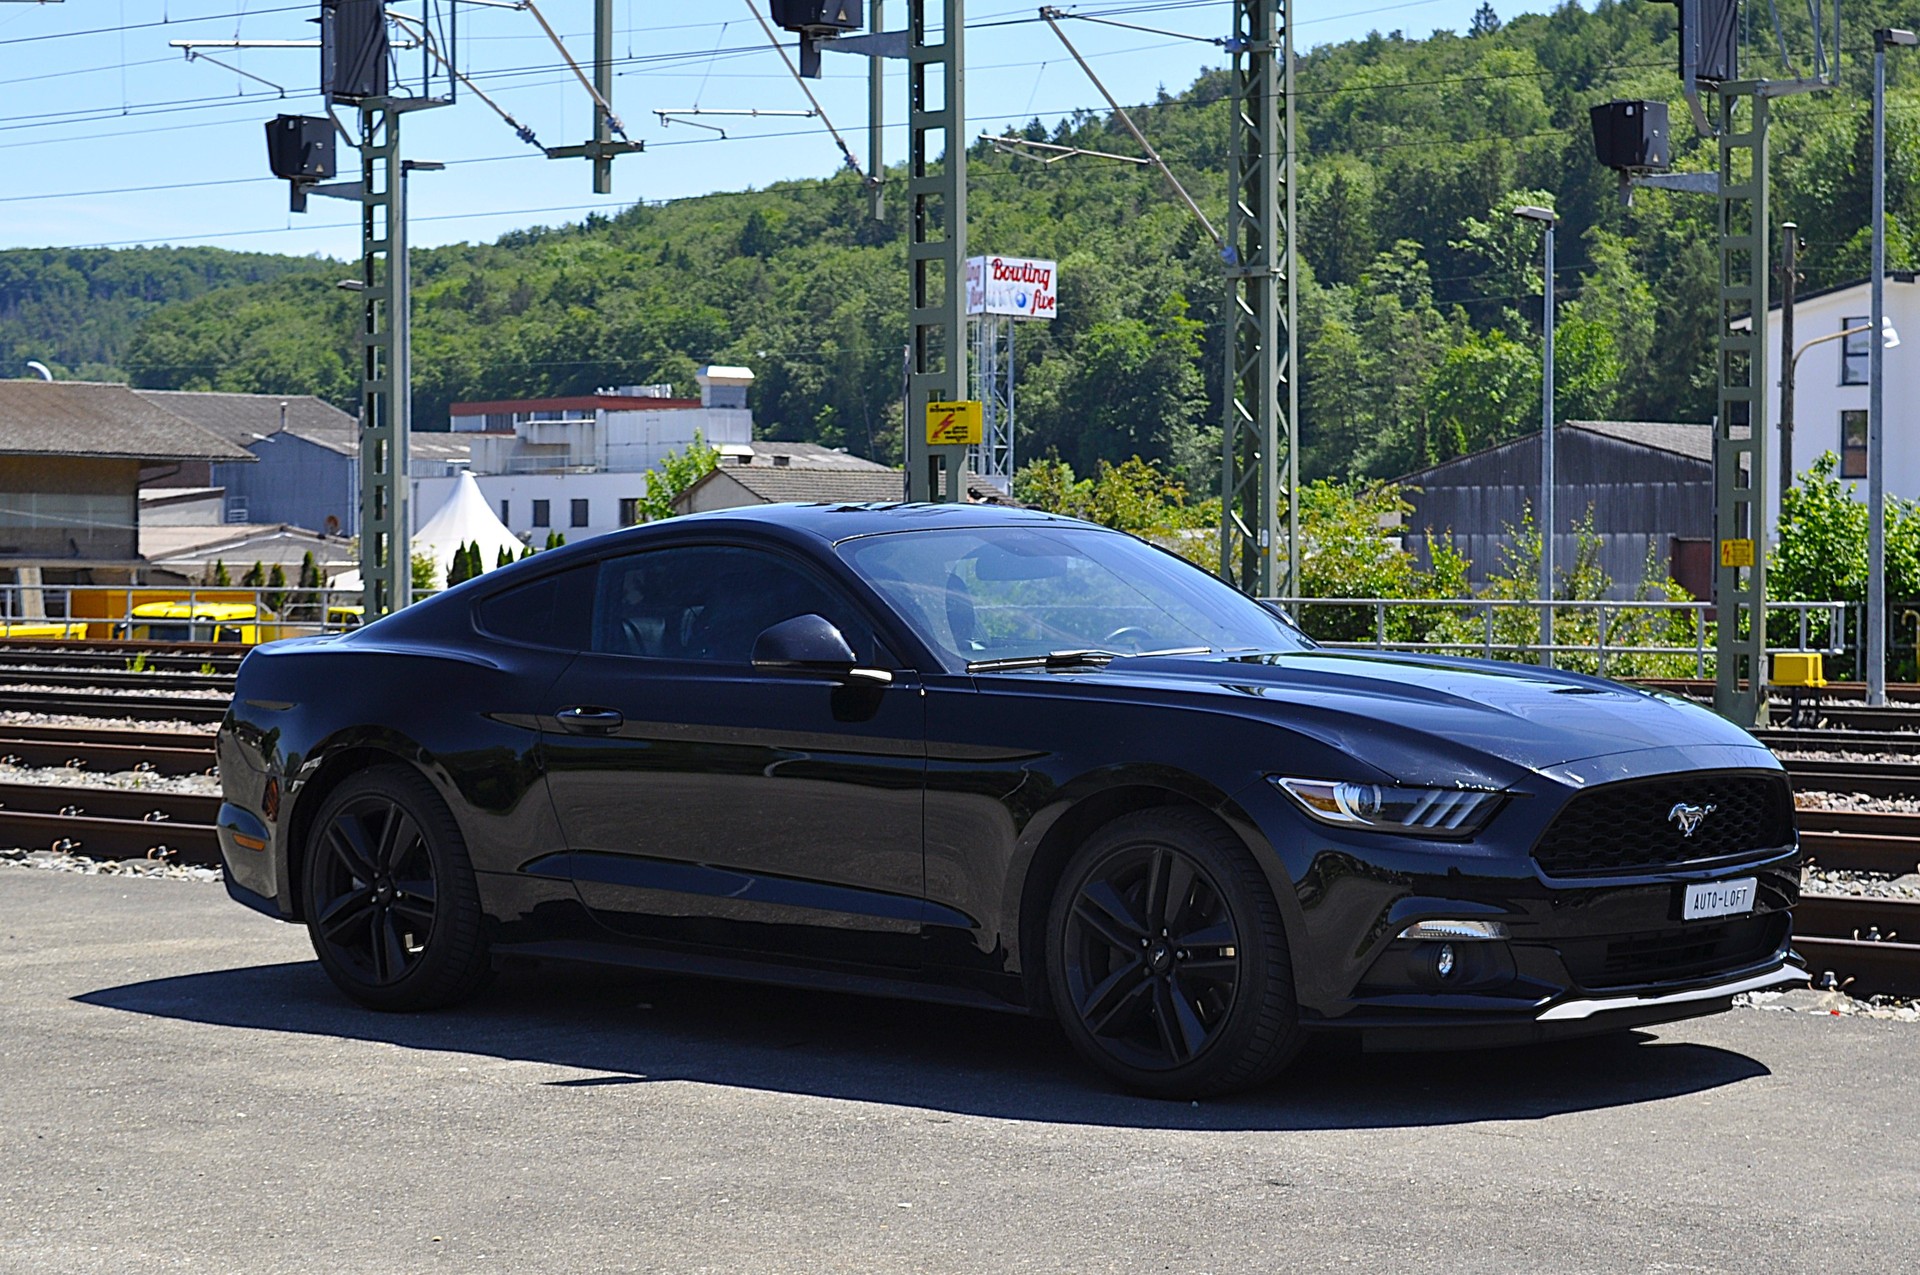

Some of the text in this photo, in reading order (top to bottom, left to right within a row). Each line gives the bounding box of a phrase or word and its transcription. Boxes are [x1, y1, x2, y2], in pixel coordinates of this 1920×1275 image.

[992, 258, 1052, 291] Bowling
[1030, 289, 1055, 315] five
[1693, 889, 1747, 910] AUTO-LOFT
